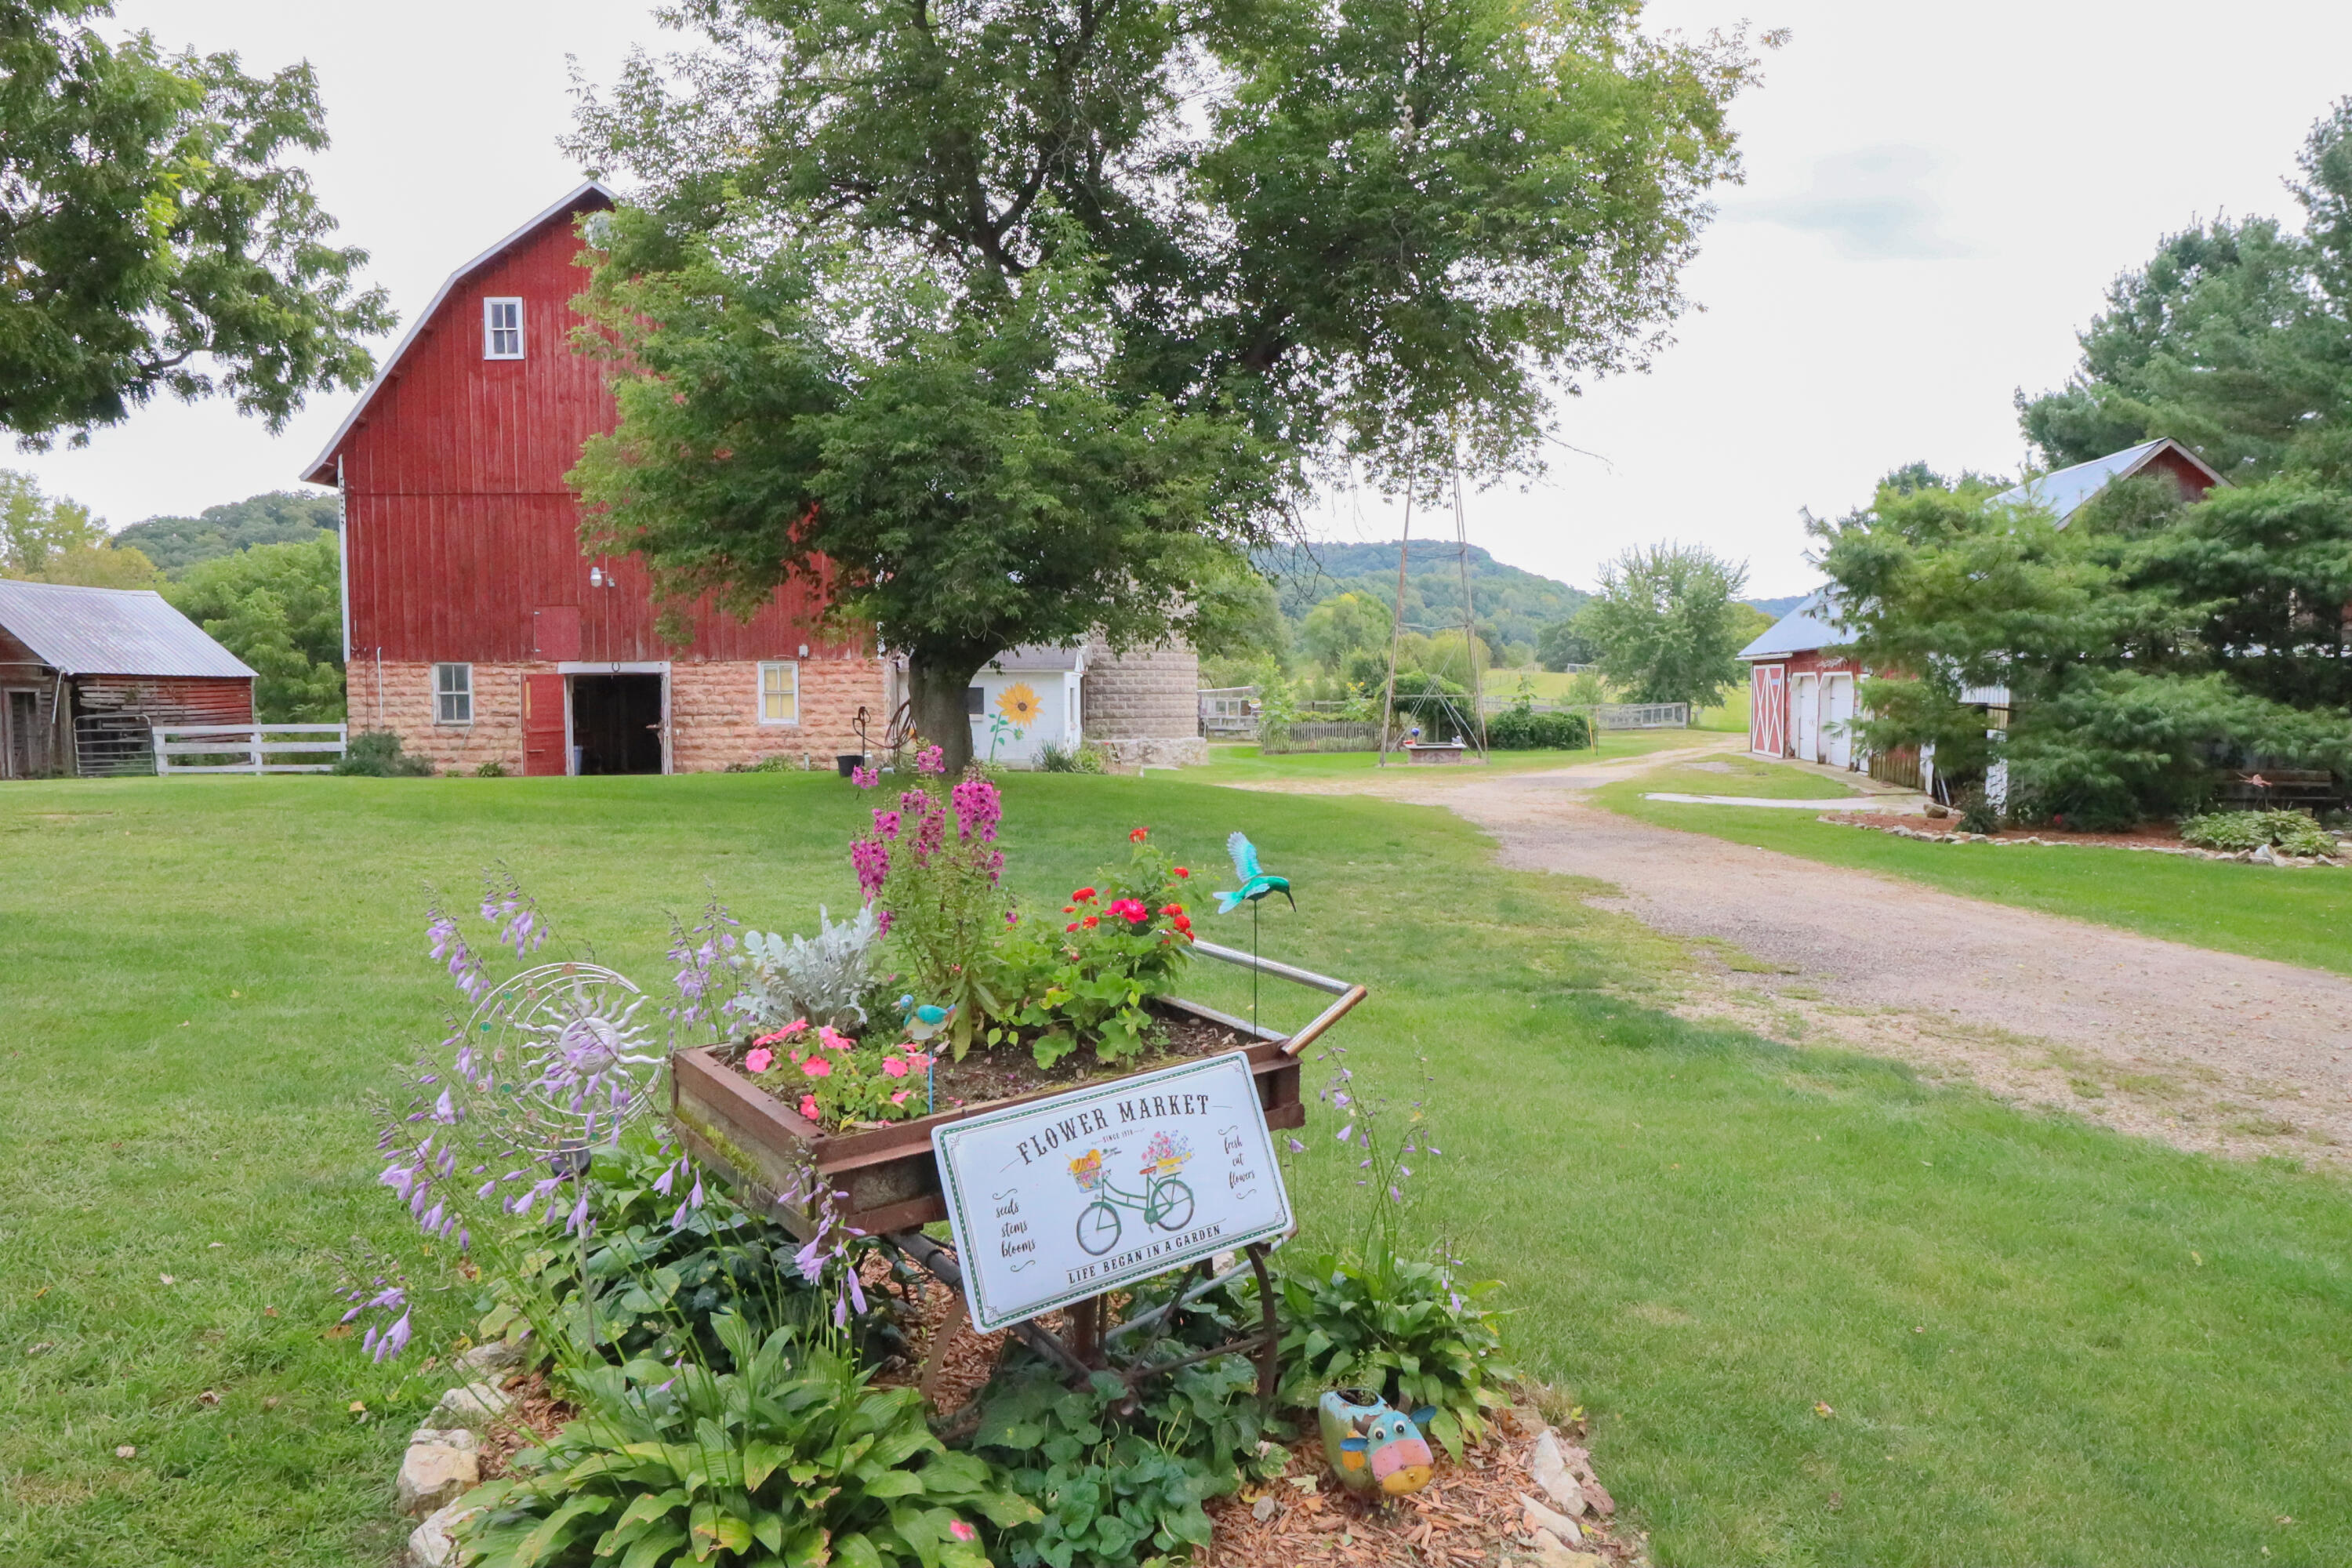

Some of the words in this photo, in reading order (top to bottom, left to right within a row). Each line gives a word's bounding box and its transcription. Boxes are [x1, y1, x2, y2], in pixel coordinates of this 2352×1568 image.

[1016, 1108, 1109, 1165] FLOWER
[1116, 1094, 1209, 1123] MARKET
[1103, 1133, 1120, 1143] SINCE
[1225, 1134, 1243, 1154] fresh
[1232, 1152, 1244, 1167] cut
[1229, 1170, 1255, 1189] flowers
[996, 1198, 1019, 1218] seeds
[1001, 1221, 1028, 1238] stems
[1001, 1239, 1036, 1258] blooms
[1069, 1265, 1096, 1284] LIFE
[1103, 1250, 1143, 1273] BEGAN
[1147, 1244, 1160, 1258] IN
[1165, 1241, 1172, 1253] A
[1176, 1225, 1221, 1248] GARDEN
